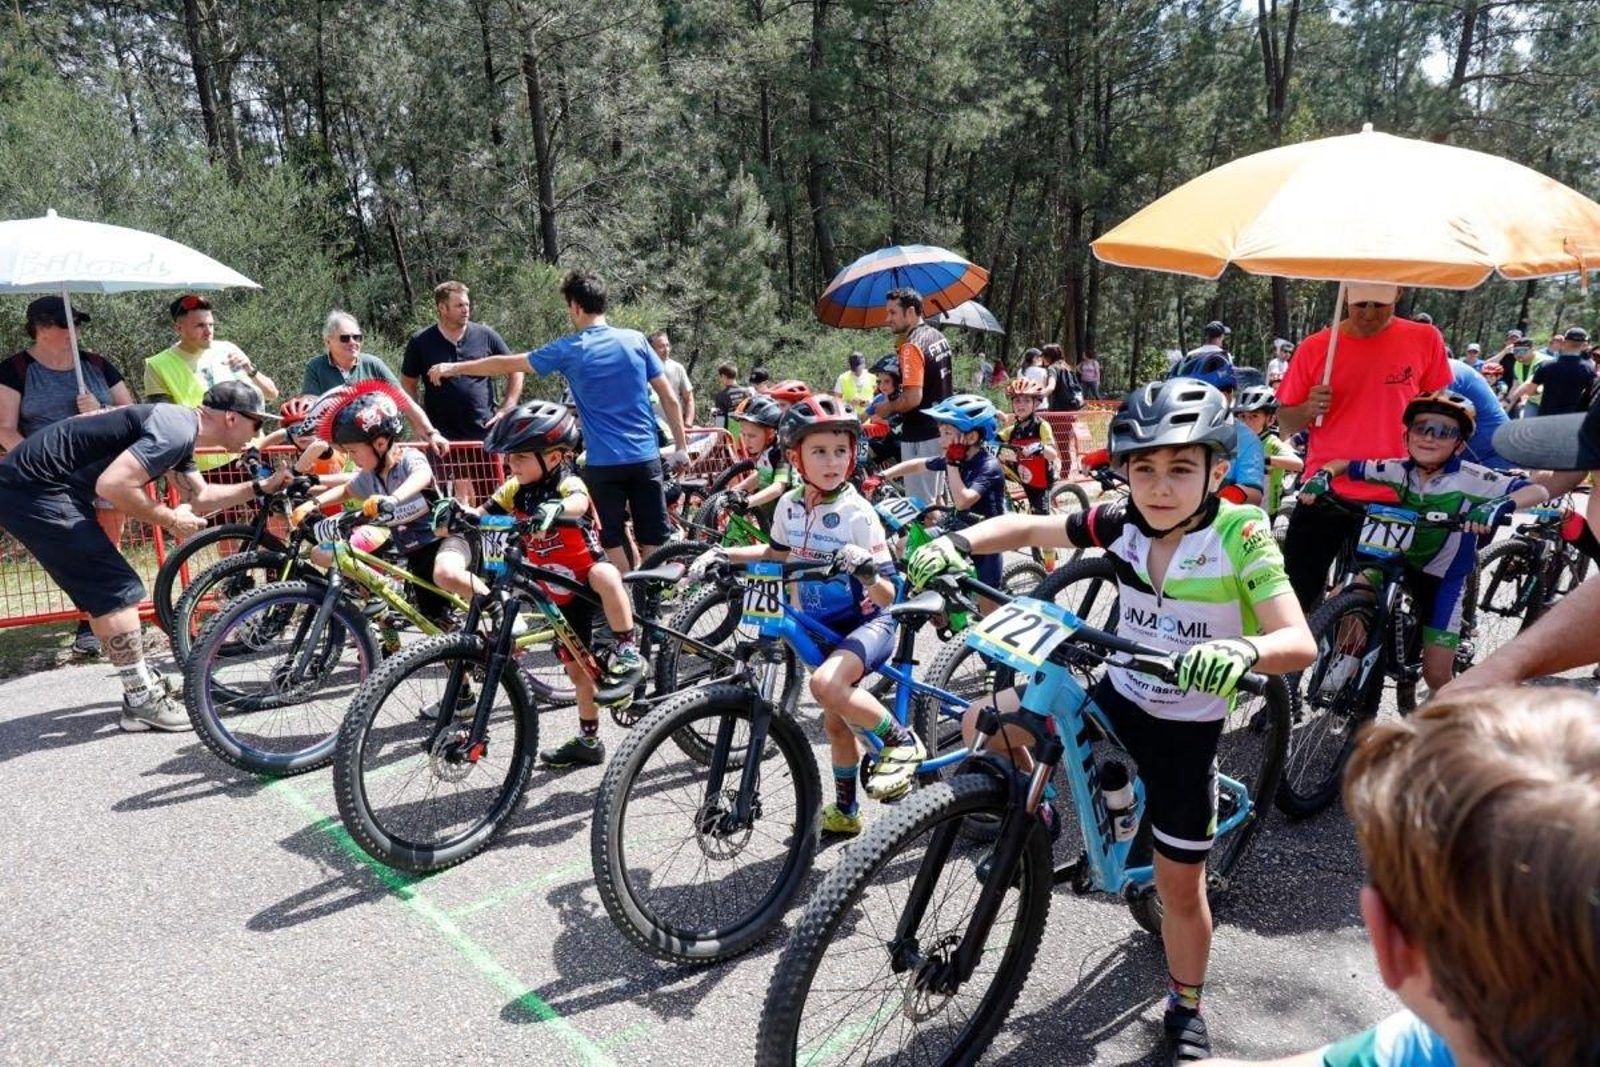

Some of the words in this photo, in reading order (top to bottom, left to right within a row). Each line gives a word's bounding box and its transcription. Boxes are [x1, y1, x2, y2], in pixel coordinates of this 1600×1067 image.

[883, 498, 917, 520] 707
[1366, 517, 1412, 549] 717
[746, 578, 780, 614] 728
[984, 606, 1061, 656] 721
